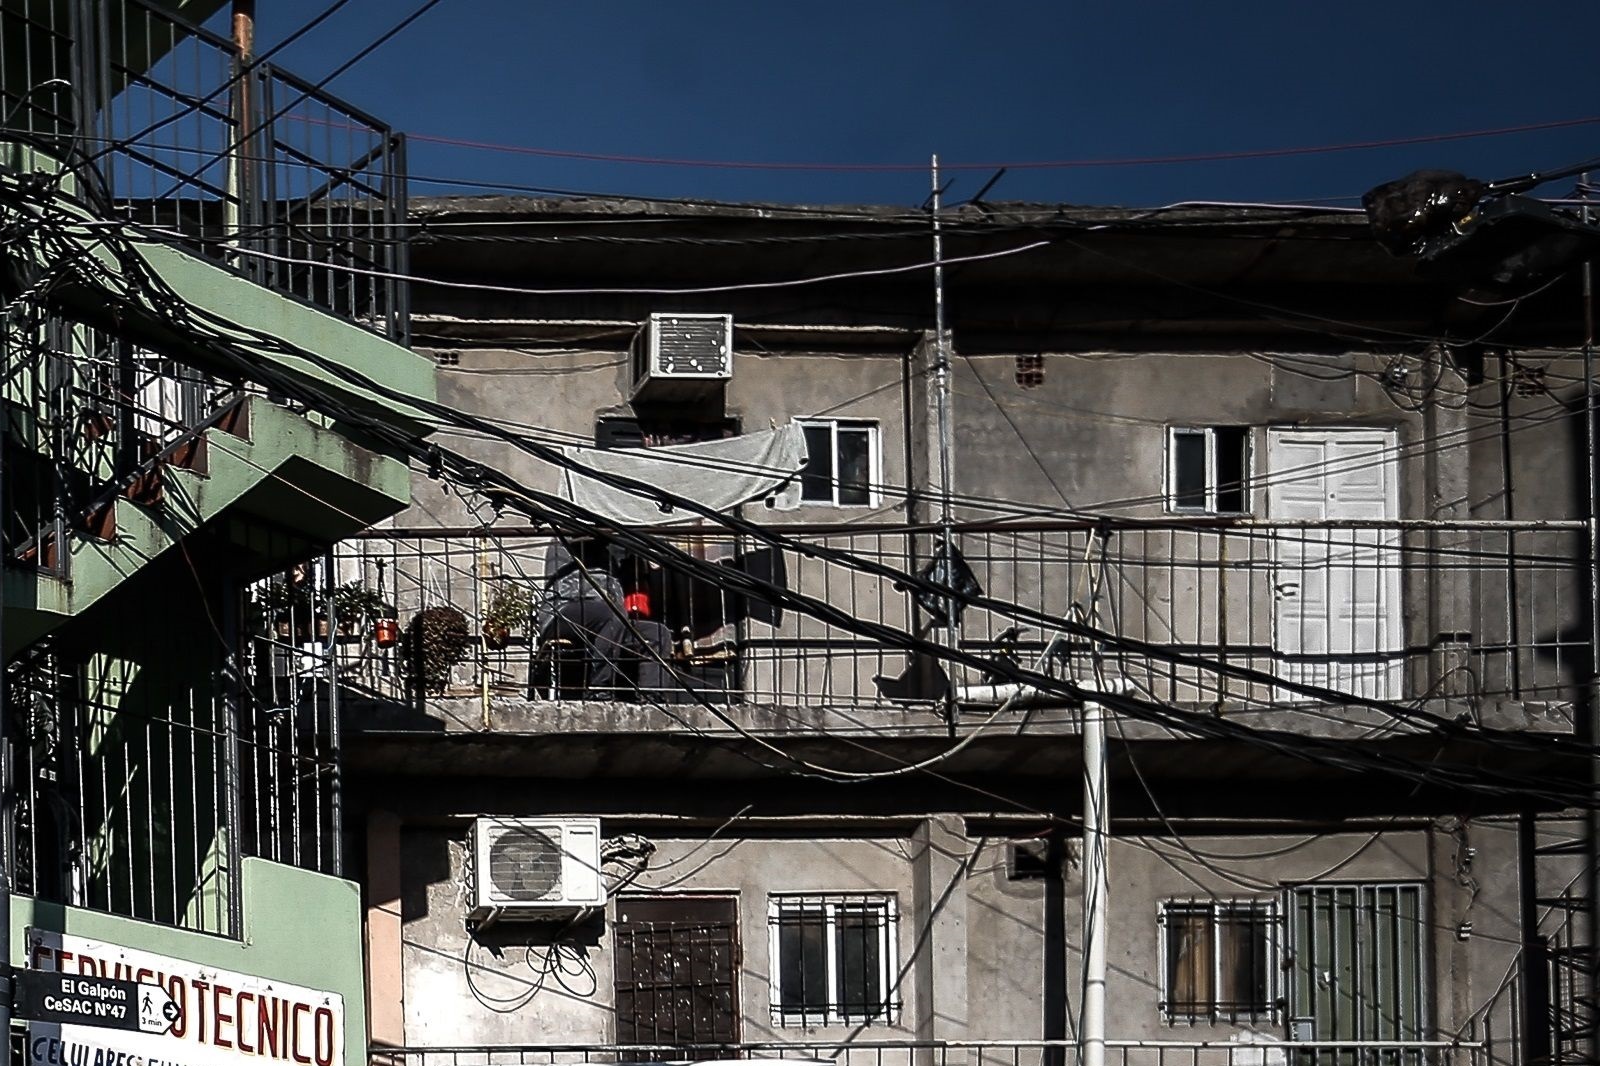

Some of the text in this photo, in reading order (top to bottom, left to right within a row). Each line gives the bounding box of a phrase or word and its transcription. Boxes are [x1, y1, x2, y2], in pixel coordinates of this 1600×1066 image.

[61, 979, 126, 1001] El Galpón
[44, 996, 92, 1015] CeSAC
[141, 1017, 162, 1027] 3 min
